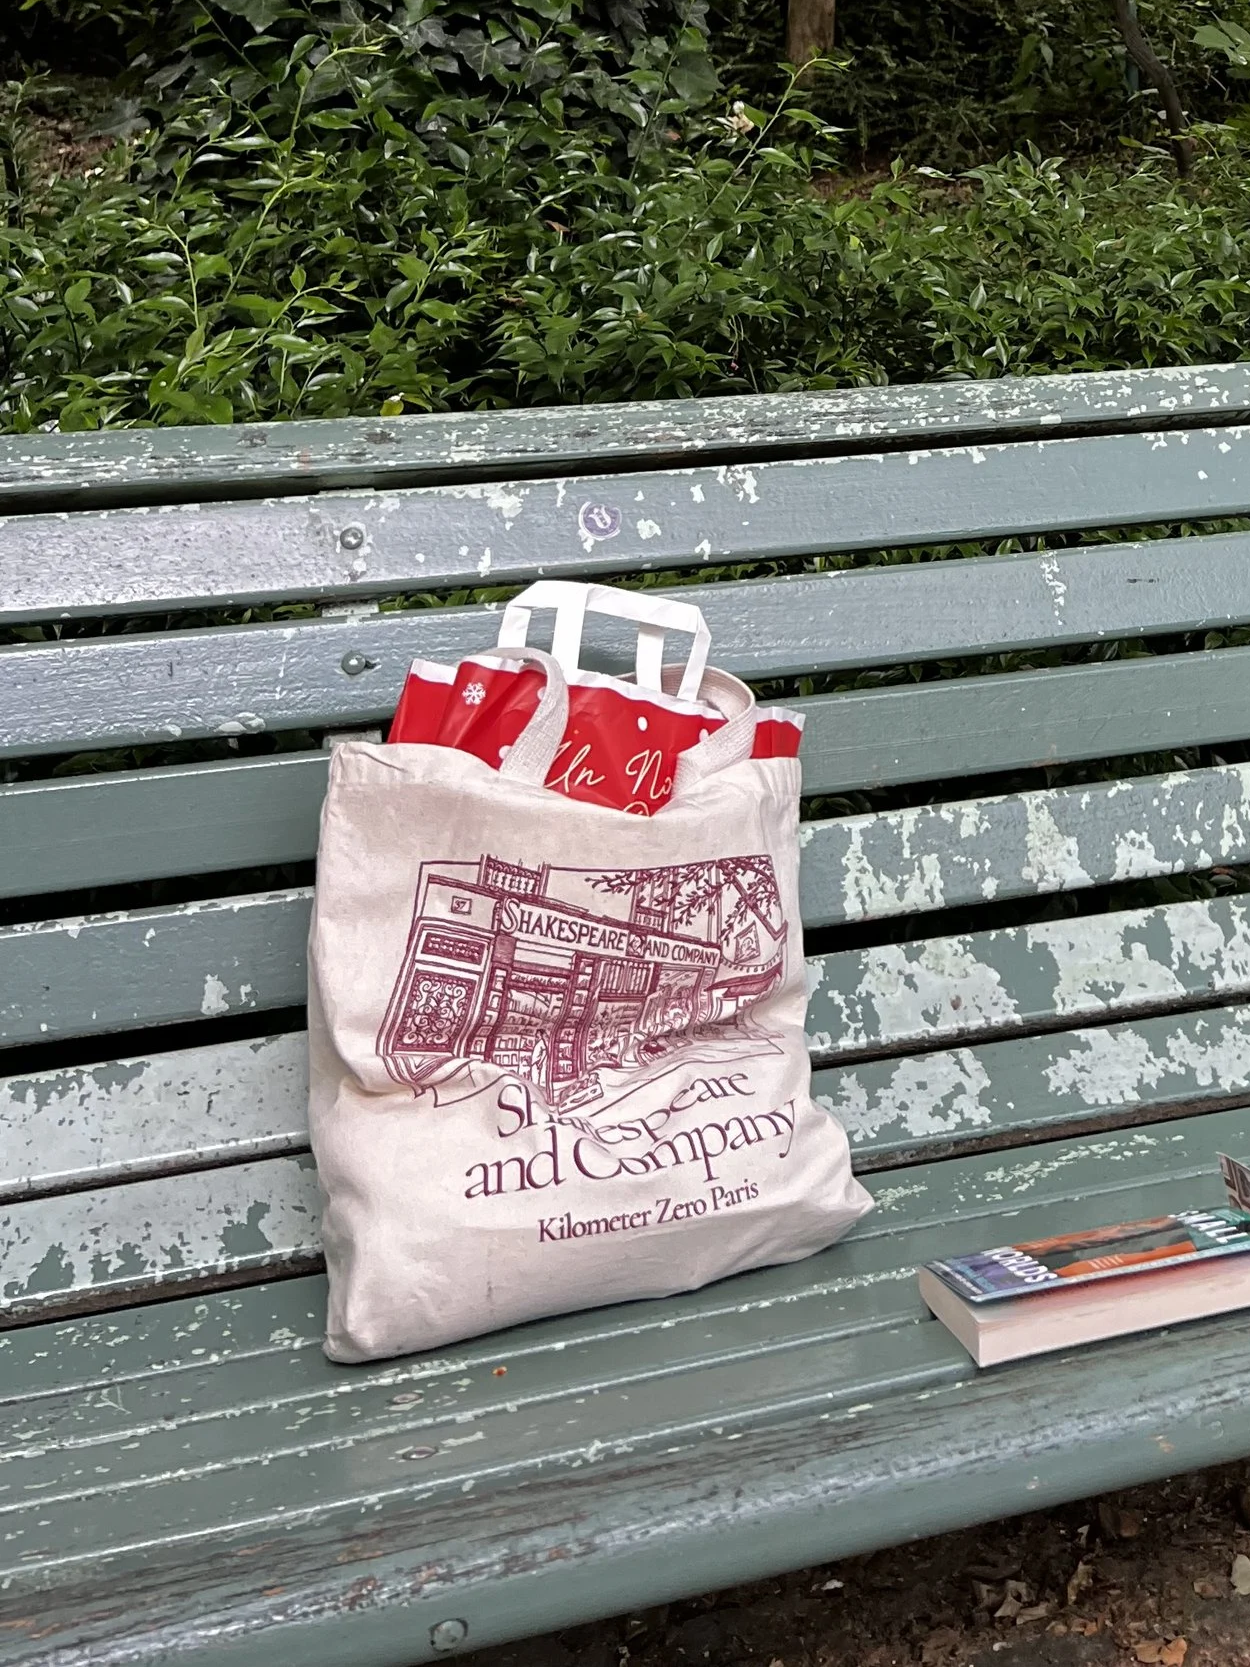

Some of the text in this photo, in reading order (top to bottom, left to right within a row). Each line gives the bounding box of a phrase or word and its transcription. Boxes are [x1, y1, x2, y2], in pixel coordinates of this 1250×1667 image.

[501, 897, 718, 966] SHAKESPEARE AND COMPANY
[464, 1098, 797, 1199] and Company
[537, 1178, 759, 1242] Kilometer Zero Paris
